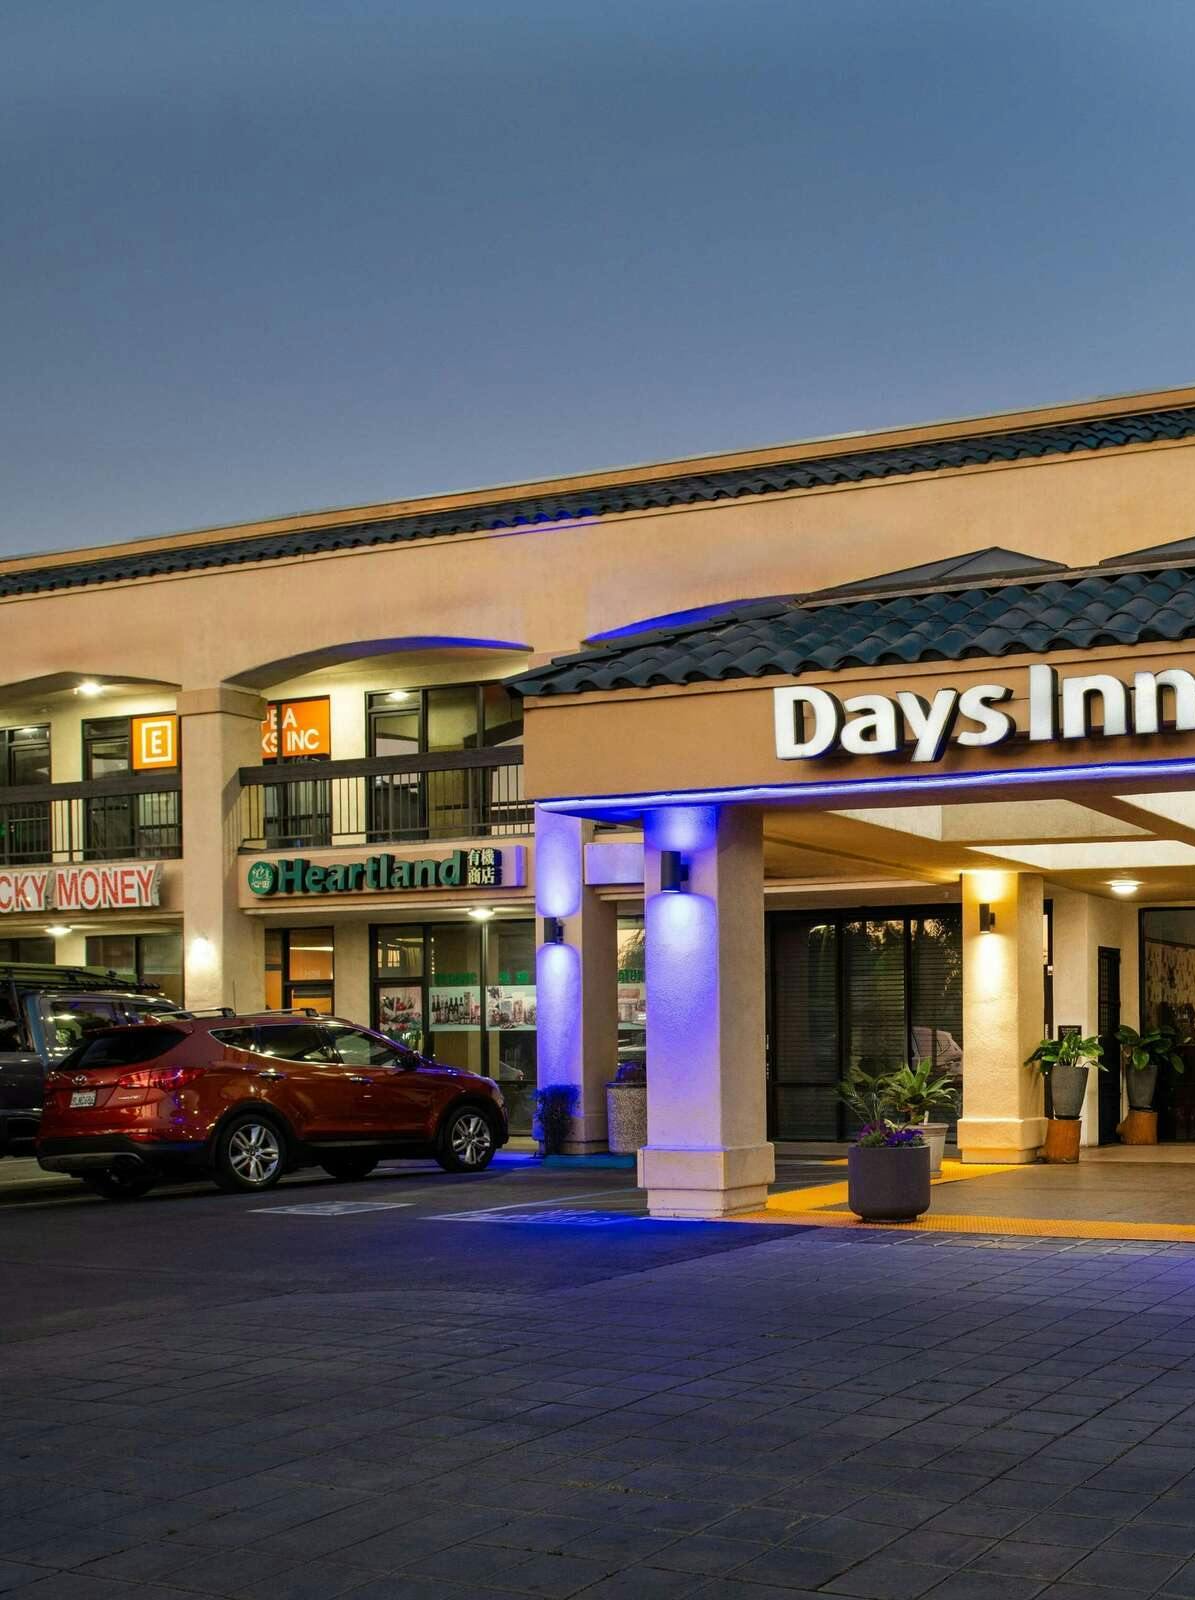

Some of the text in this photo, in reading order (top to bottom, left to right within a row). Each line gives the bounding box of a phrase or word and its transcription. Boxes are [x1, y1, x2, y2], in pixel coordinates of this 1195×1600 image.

[287, 729, 320, 752] INC
[773, 685, 1014, 763] Days
[56, 866, 155, 909] MONEY
[278, 850, 465, 894] Heartland
